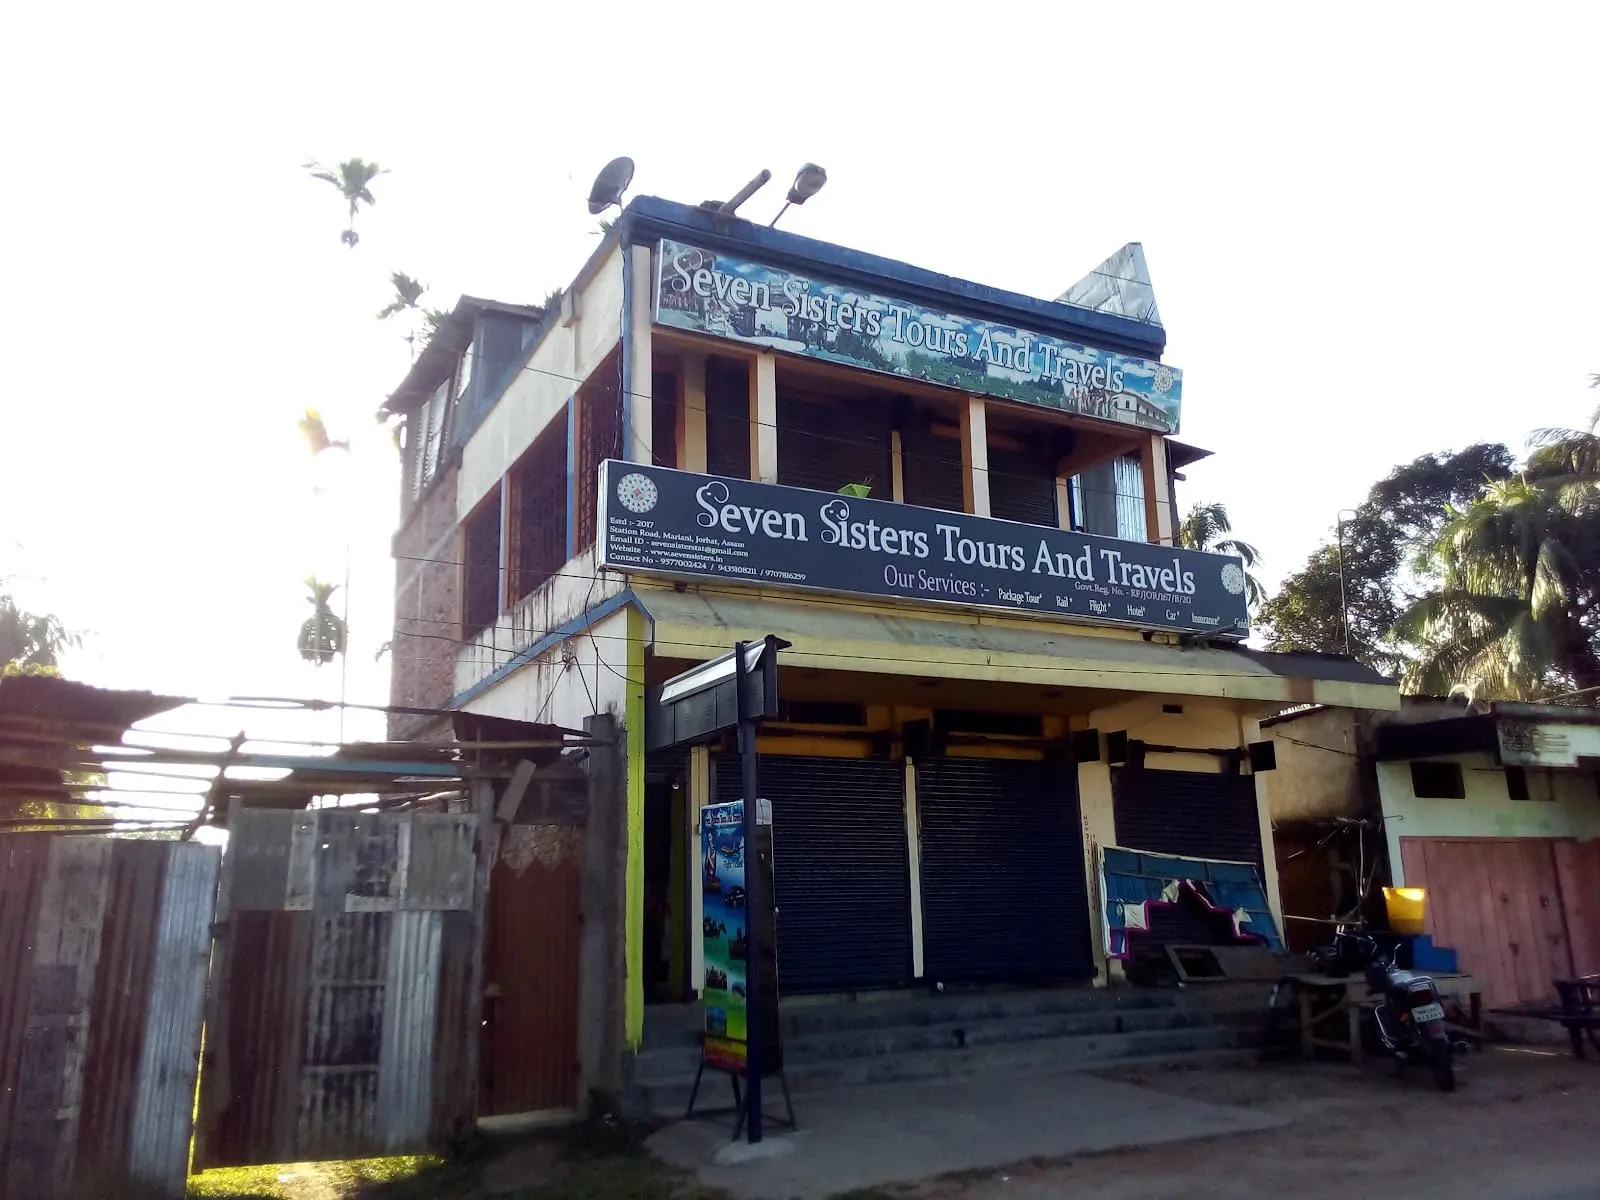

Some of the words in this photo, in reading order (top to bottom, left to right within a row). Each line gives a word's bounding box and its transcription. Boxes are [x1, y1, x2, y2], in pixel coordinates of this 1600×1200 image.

[672, 249, 771, 311] Seven
[781, 278, 881, 336] Sisters
[888, 305, 968, 358] Tours
[973, 328, 1031, 373] And
[1038, 342, 1124, 393] Travels
[610, 517, 627, 525] Estd
[636, 520, 654, 528] 2017
[610, 526, 638, 535] Station
[640, 529, 661, 538] Road,
[663, 532, 694, 542] Mariani,
[695, 536, 720, 547] Jorhat,
[721, 539, 745, 548] Assam
[610, 535, 633, 544] Email
[696, 481, 808, 541] Seven
[820, 499, 929, 558] Sisters
[936, 524, 1026, 572] Tours
[1032, 540, 1094, 581] And
[1100, 549, 1196, 595] Travels
[610, 544, 641, 553] Website
[609, 553, 640, 562] Contact
[660, 558, 707, 569] 9577002424
[884, 564, 914, 588] Our
[918, 569, 976, 596] Services
[998, 588, 1024, 605] Package
[1111, 586, 1124, 596] No.
